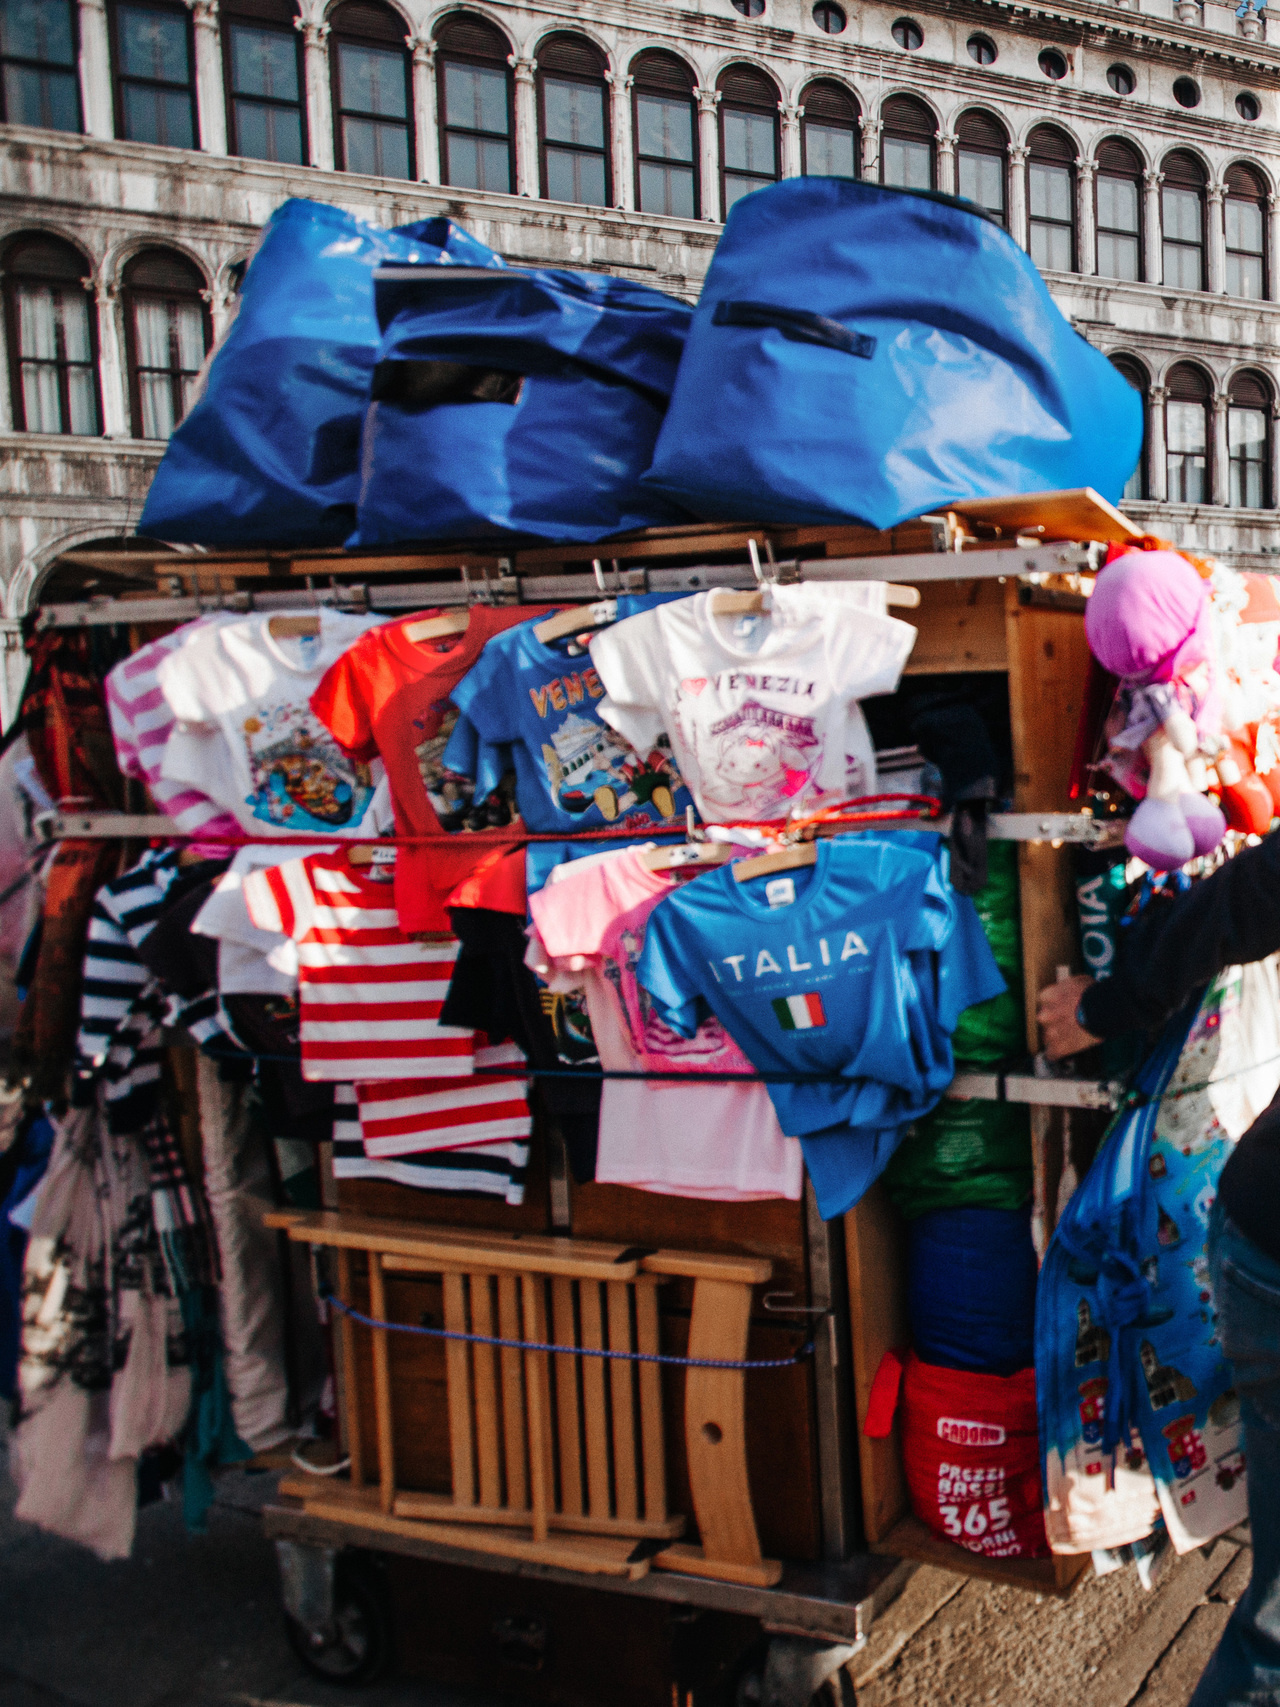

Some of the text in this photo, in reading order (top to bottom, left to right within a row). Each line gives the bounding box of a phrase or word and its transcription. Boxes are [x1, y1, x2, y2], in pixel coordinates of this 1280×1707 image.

[708, 930, 869, 983] ITALIA
[938, 1462, 1005, 1482] PREZZI
[938, 1478, 1005, 1498] BASSI
[939, 1498, 1011, 1537] 365
